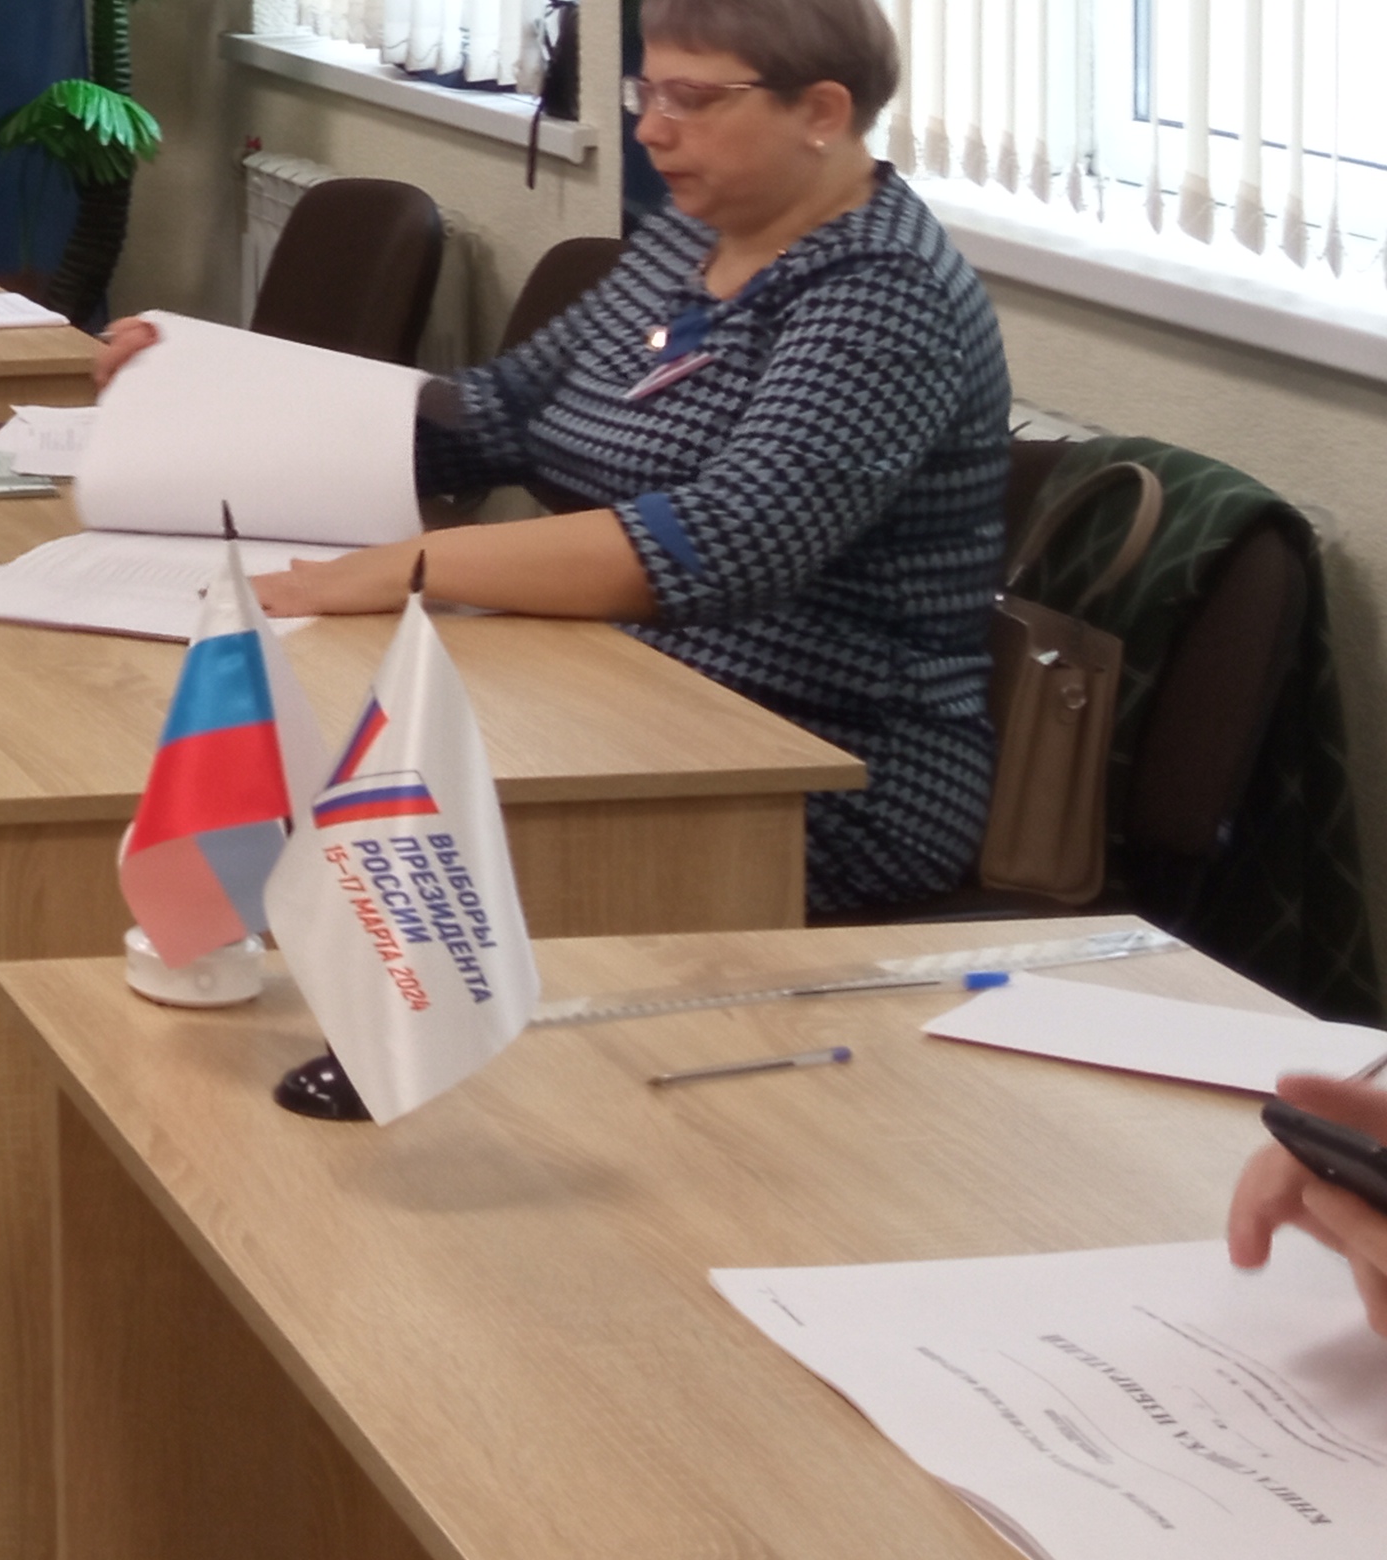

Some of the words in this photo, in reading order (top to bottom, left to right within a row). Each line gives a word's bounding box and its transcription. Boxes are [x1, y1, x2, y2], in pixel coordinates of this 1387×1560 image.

[351, 838, 433, 944] РОССИИ
[389, 835, 494, 1004] ПРЕЗИДЕНТА
[426, 833, 497, 949] ВЫБОРЫ
[349, 897, 404, 962] МАРТА
[387, 965, 432, 1012] 2024
